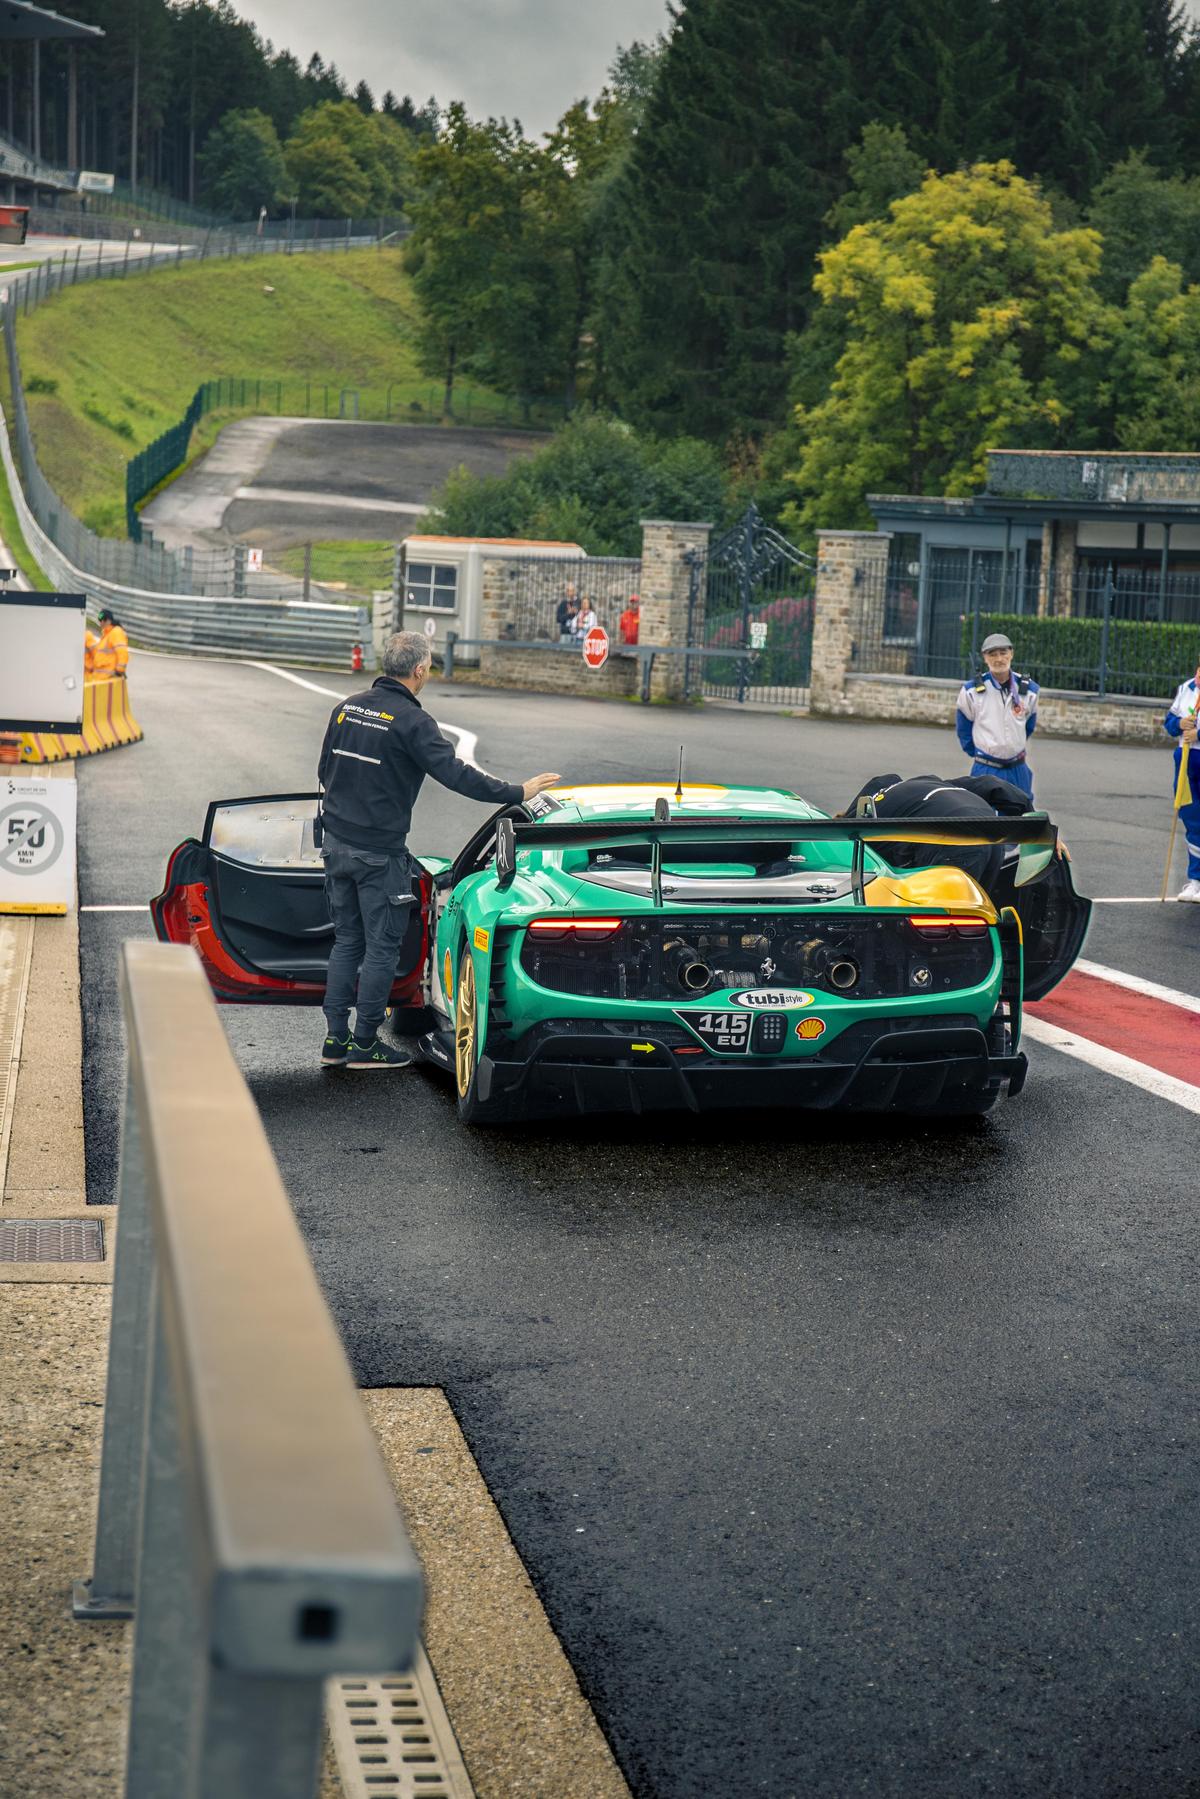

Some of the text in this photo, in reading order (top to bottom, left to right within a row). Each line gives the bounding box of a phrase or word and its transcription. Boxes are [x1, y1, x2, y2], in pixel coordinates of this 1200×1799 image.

[585, 638, 607, 655] STOP
[8, 818, 45, 848] 50
[745, 993, 803, 1005] tubi style
[698, 1013, 748, 1034] 115
[717, 1035, 746, 1046] EU
